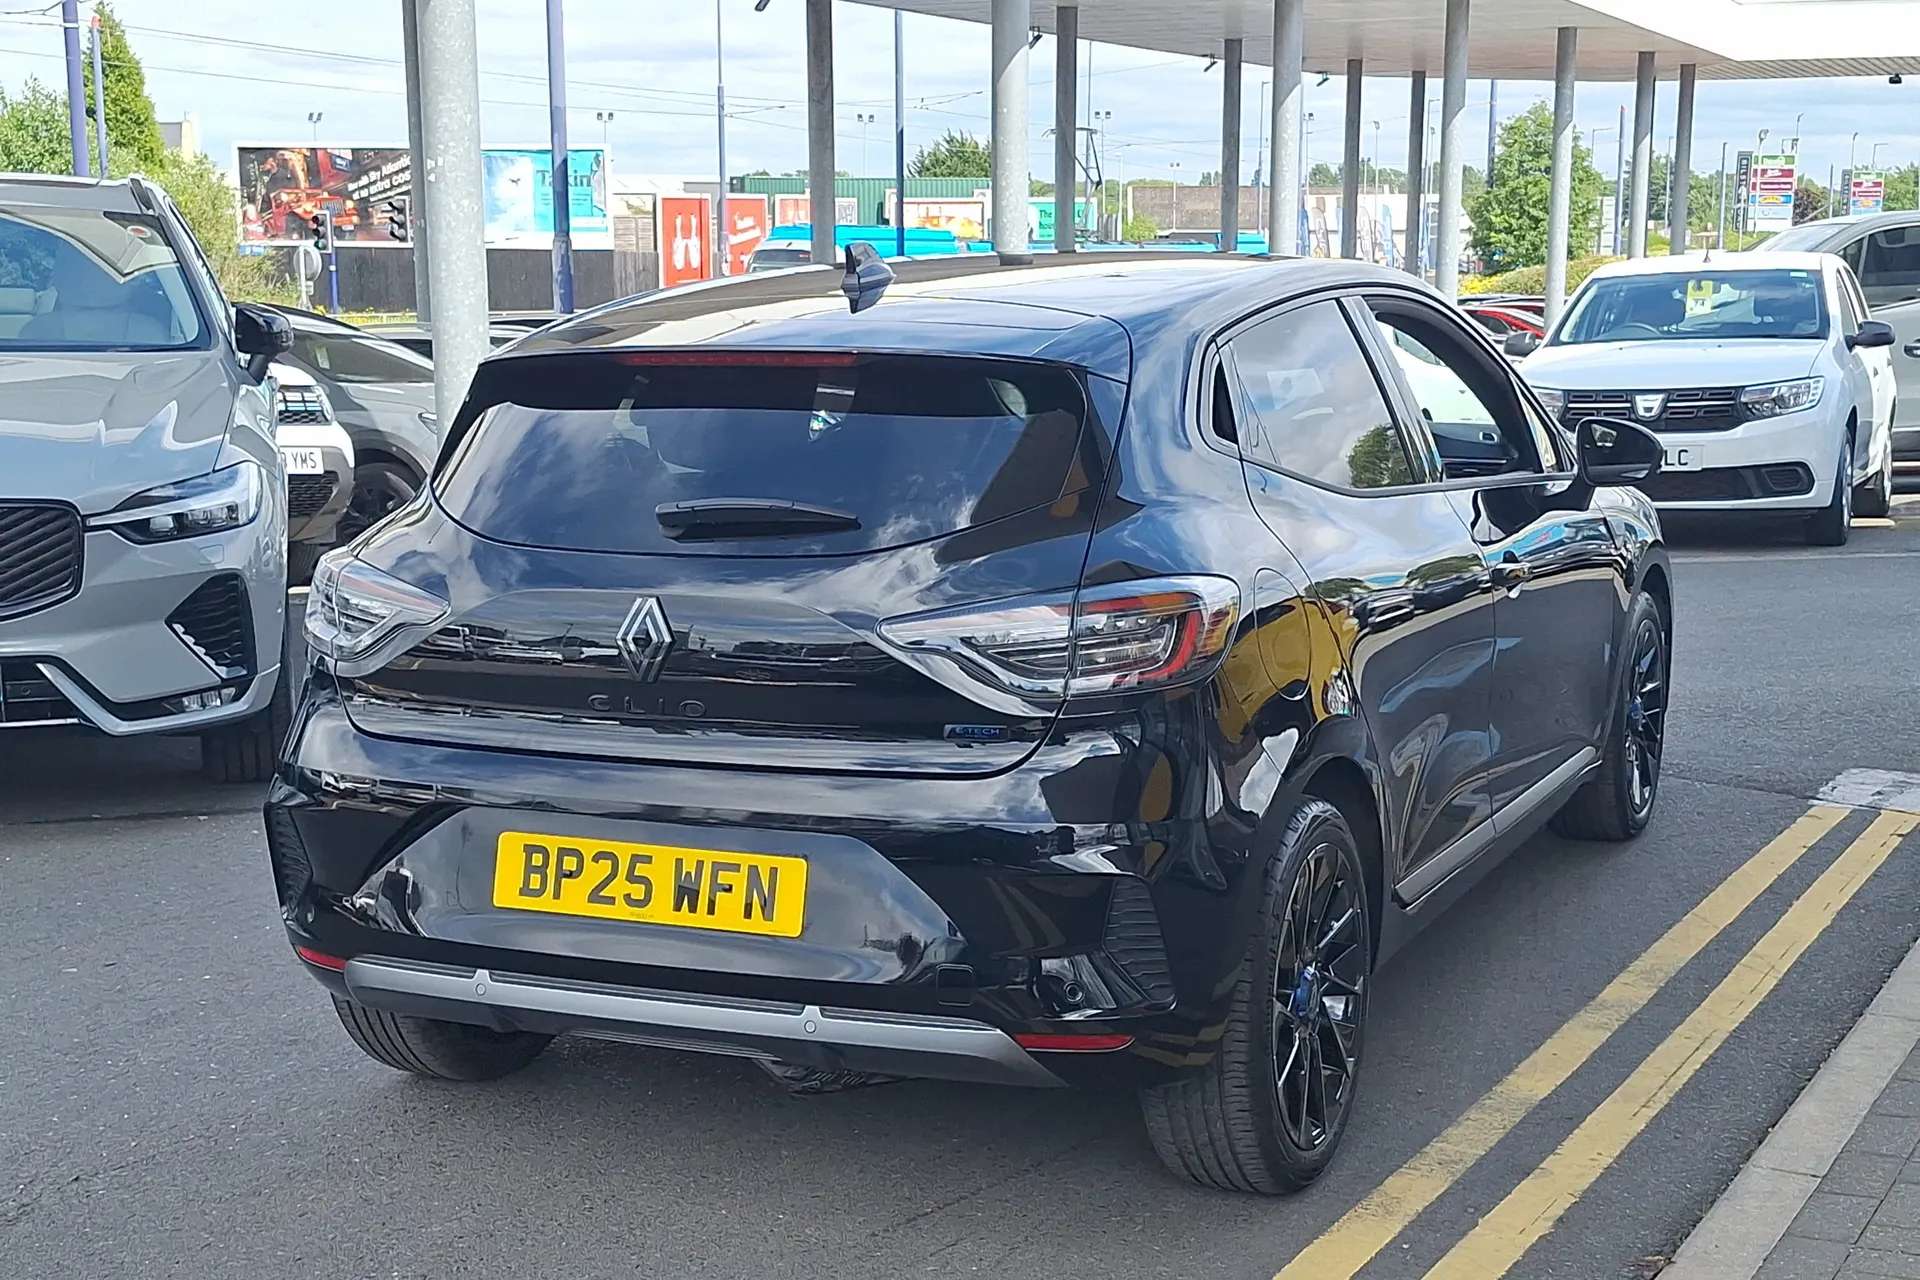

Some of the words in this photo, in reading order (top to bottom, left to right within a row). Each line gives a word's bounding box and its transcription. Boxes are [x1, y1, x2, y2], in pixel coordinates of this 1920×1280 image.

[391, 170, 412, 186] cos
[291, 451, 317, 469] YMS
[1664, 449, 1689, 466] LC
[587, 693, 706, 718] CLIO
[519, 843, 654, 909] BP25
[672, 857, 778, 922] WFN
